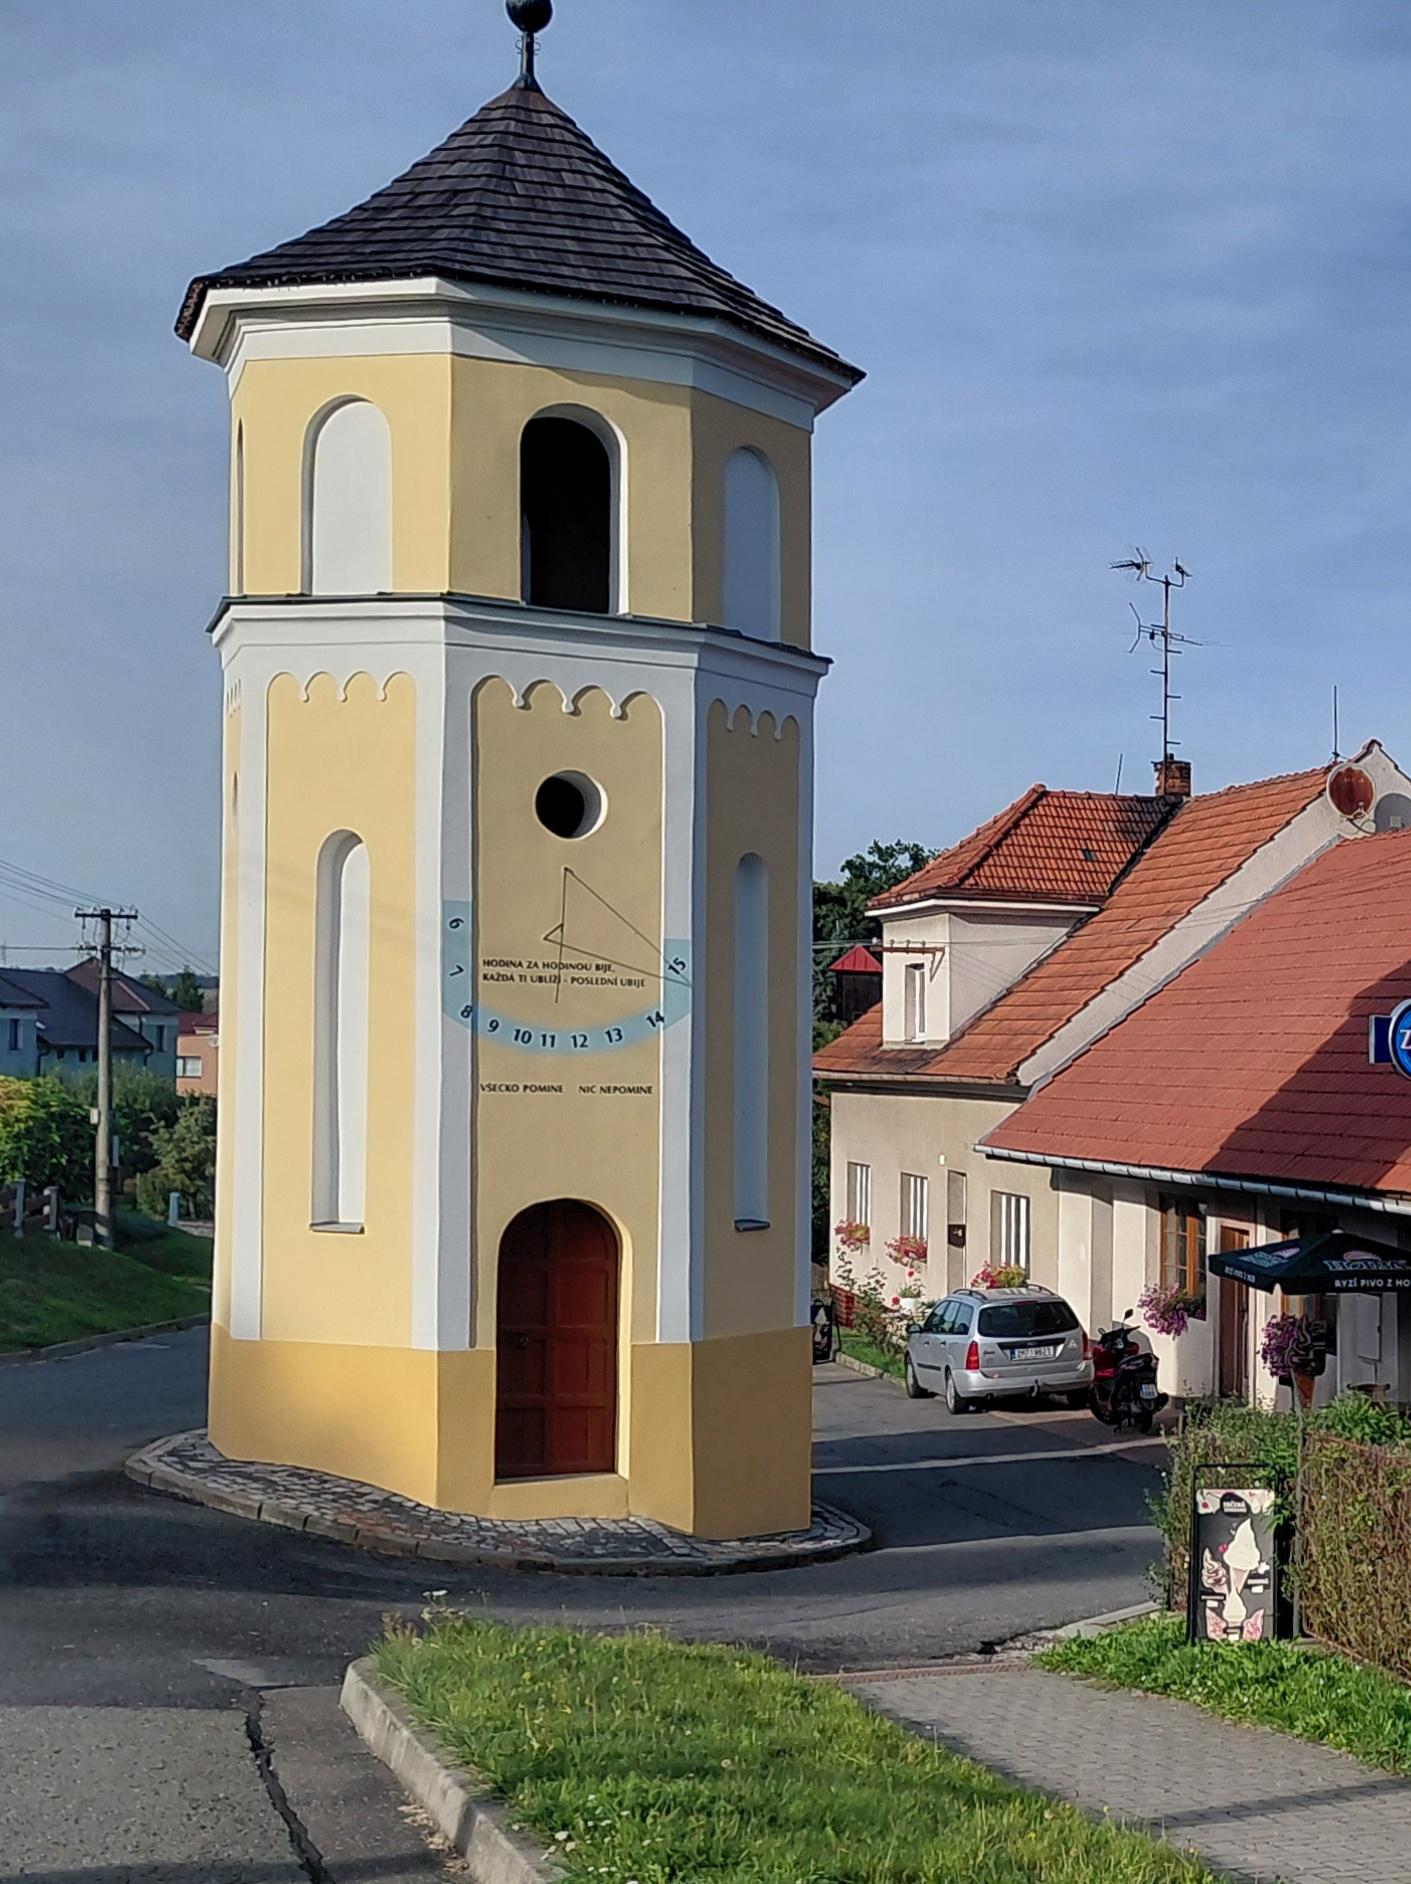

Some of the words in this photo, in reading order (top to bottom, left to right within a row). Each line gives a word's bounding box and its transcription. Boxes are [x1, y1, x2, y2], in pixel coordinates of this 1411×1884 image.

[448, 918, 465, 930] 6
[448, 964, 465, 977] 7
[482, 958, 524, 970] HODINA
[526, 960, 539, 970] ZA
[542, 961, 592, 972] HODINOU
[667, 956, 687, 975] 15
[518, 974, 528, 983] TI
[570, 975, 618, 987] POSLEDNÍ
[620, 978, 646, 989] UBIJE
[460, 1004, 474, 1019] 8
[645, 1010, 665, 1028] 14
[487, 1019, 500, 1033] 9
[513, 1028, 533, 1045] 10
[540, 1033, 556, 1049] 11
[570, 1033, 589, 1049] 12
[604, 1027, 624, 1044] 13
[480, 1082, 520, 1094] VŠECKO
[523, 1083, 564, 1094] POMINE
[578, 1084, 597, 1095] NIC
[599, 1085, 654, 1096] NEPOMINE
[1360, 1279, 1384, 1288] PIVO
[1386, 1279, 1393, 1288] Z
